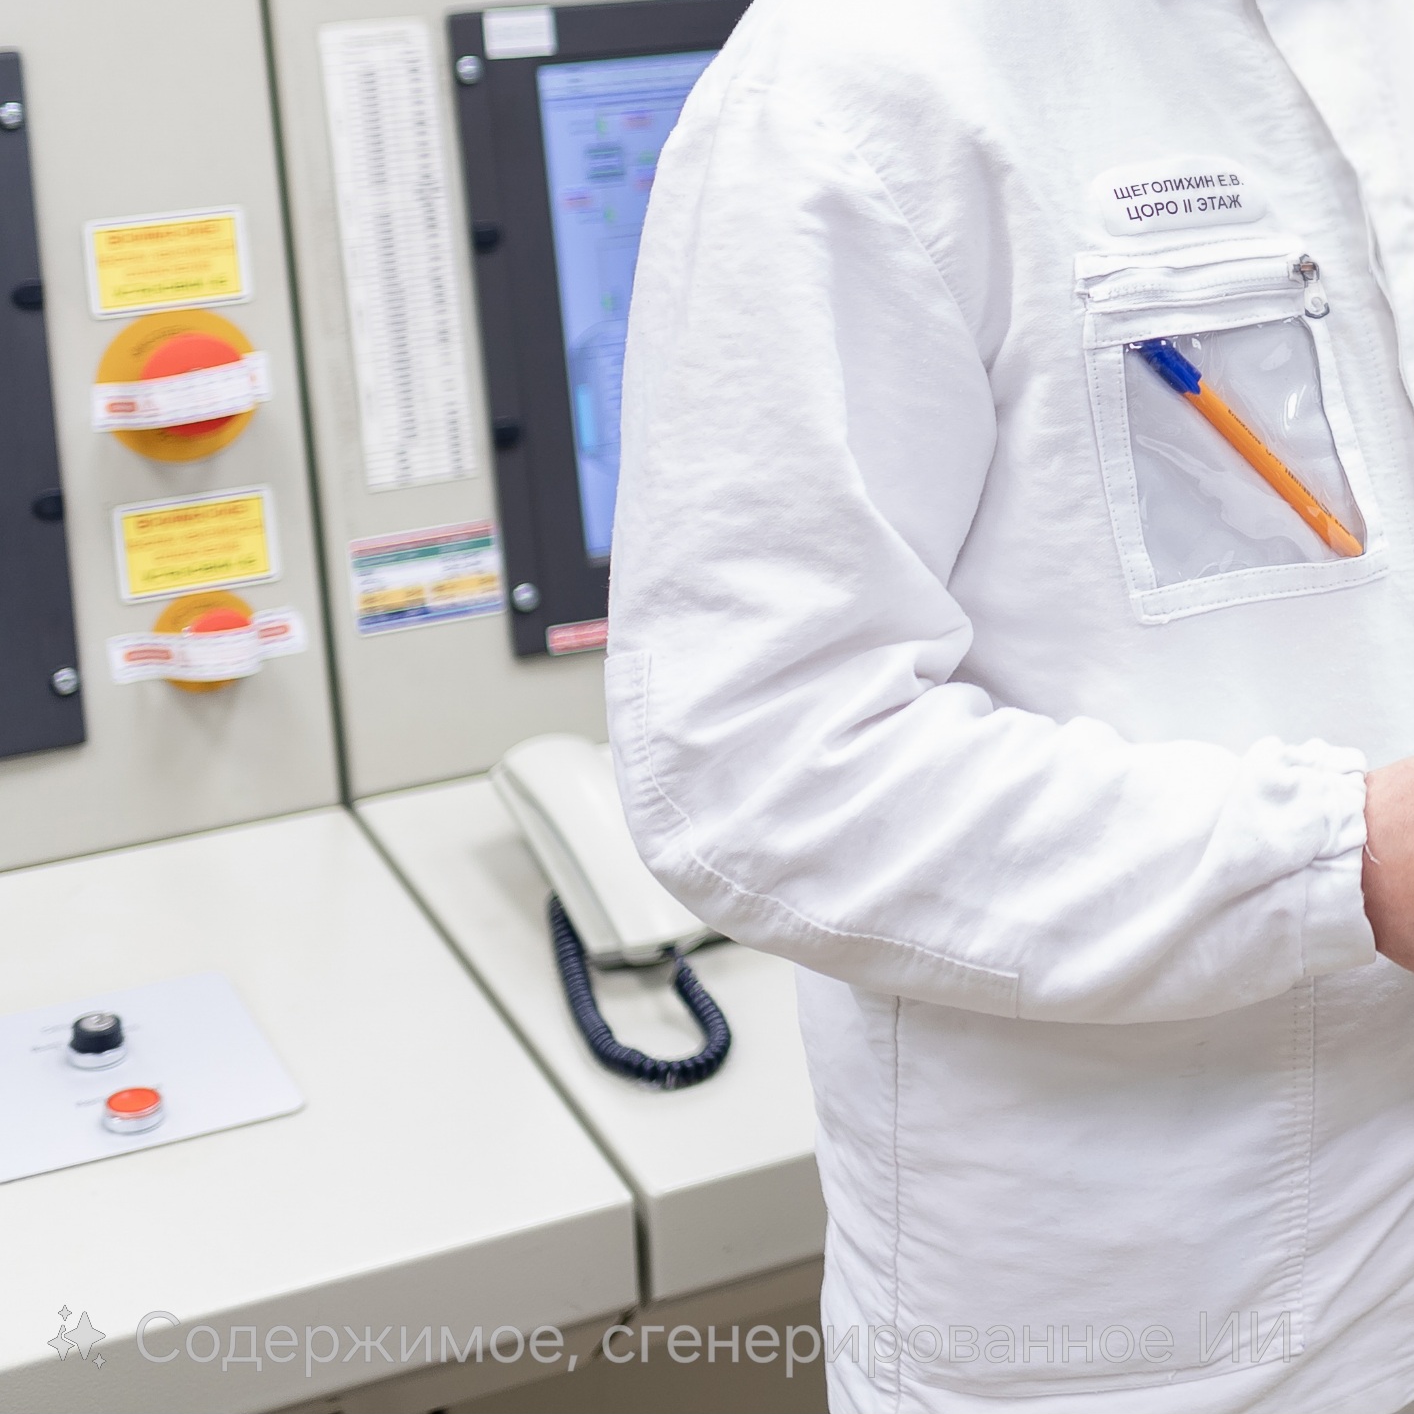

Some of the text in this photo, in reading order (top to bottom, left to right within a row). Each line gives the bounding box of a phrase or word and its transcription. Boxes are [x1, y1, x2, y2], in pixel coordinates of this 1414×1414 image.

[1113, 174, 1244, 200] ЩЕГОЛИХИН Е.В.
[1126, 193, 1243, 221] ЦОРО II ЭТАЖ
